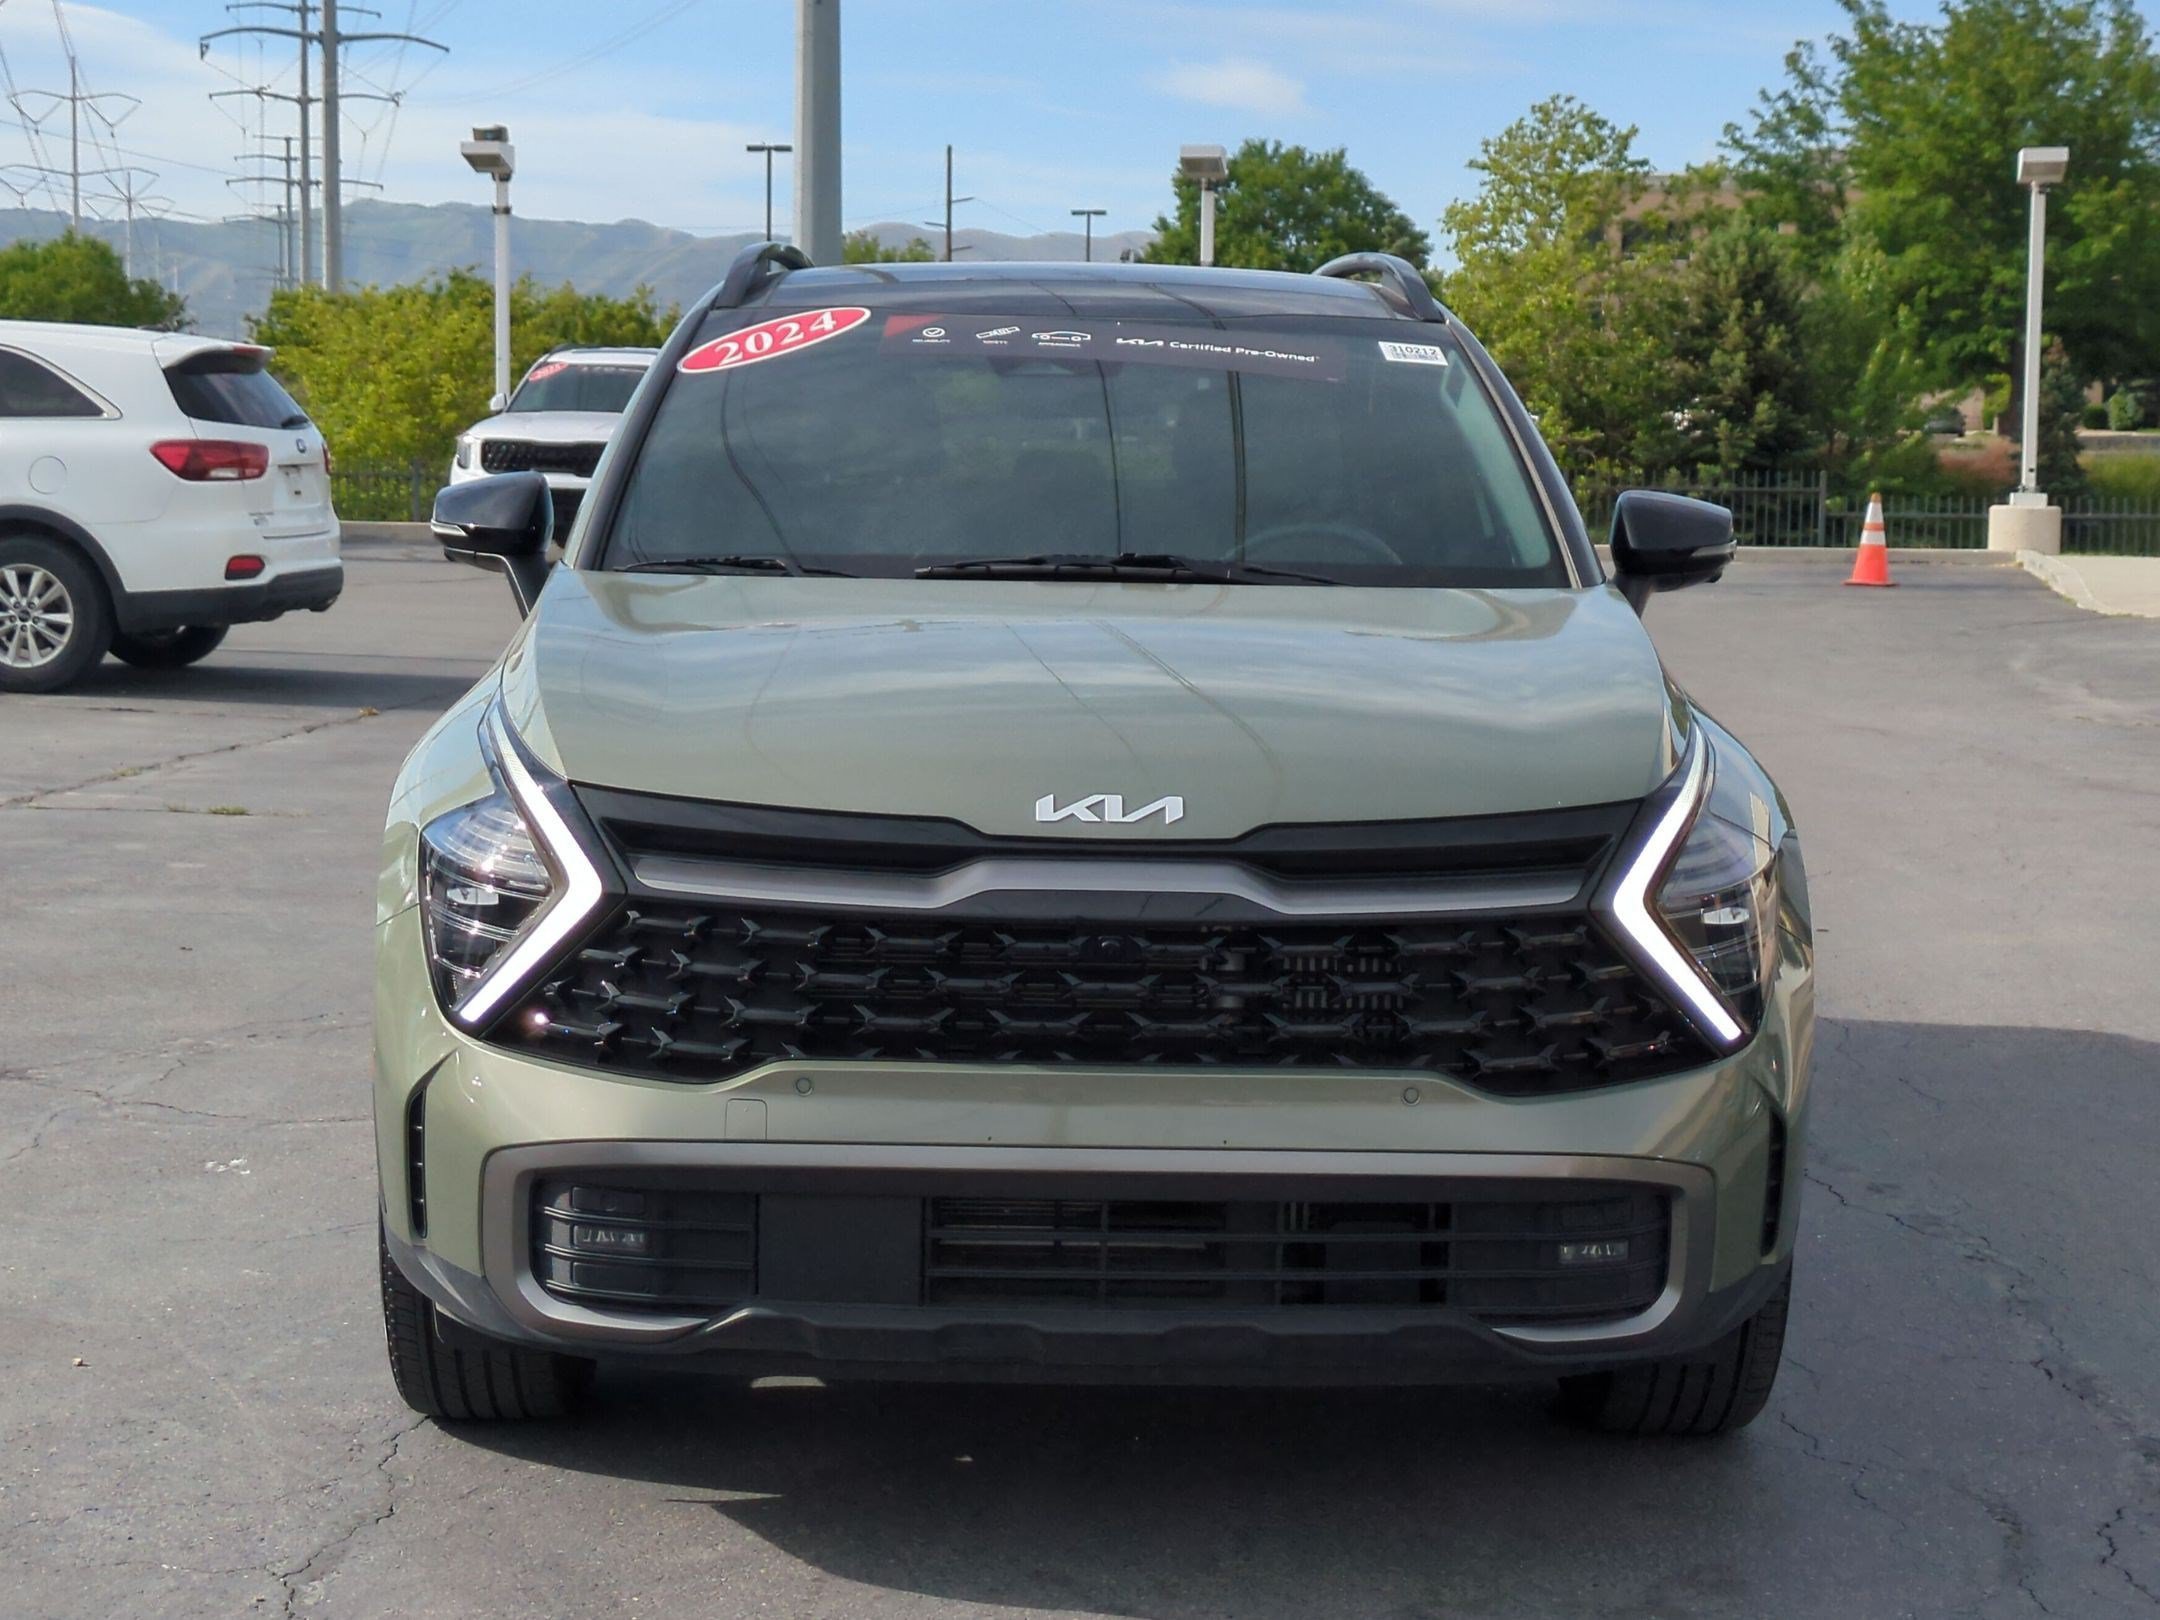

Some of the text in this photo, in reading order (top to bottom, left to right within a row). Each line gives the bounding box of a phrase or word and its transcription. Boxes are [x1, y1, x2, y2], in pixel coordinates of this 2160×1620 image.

[714, 311, 837, 366] 2024
[1169, 341, 1231, 353] Certified
[1235, 347, 1315, 362] Pre-Owned
[1036, 794, 1184, 824] KIA
